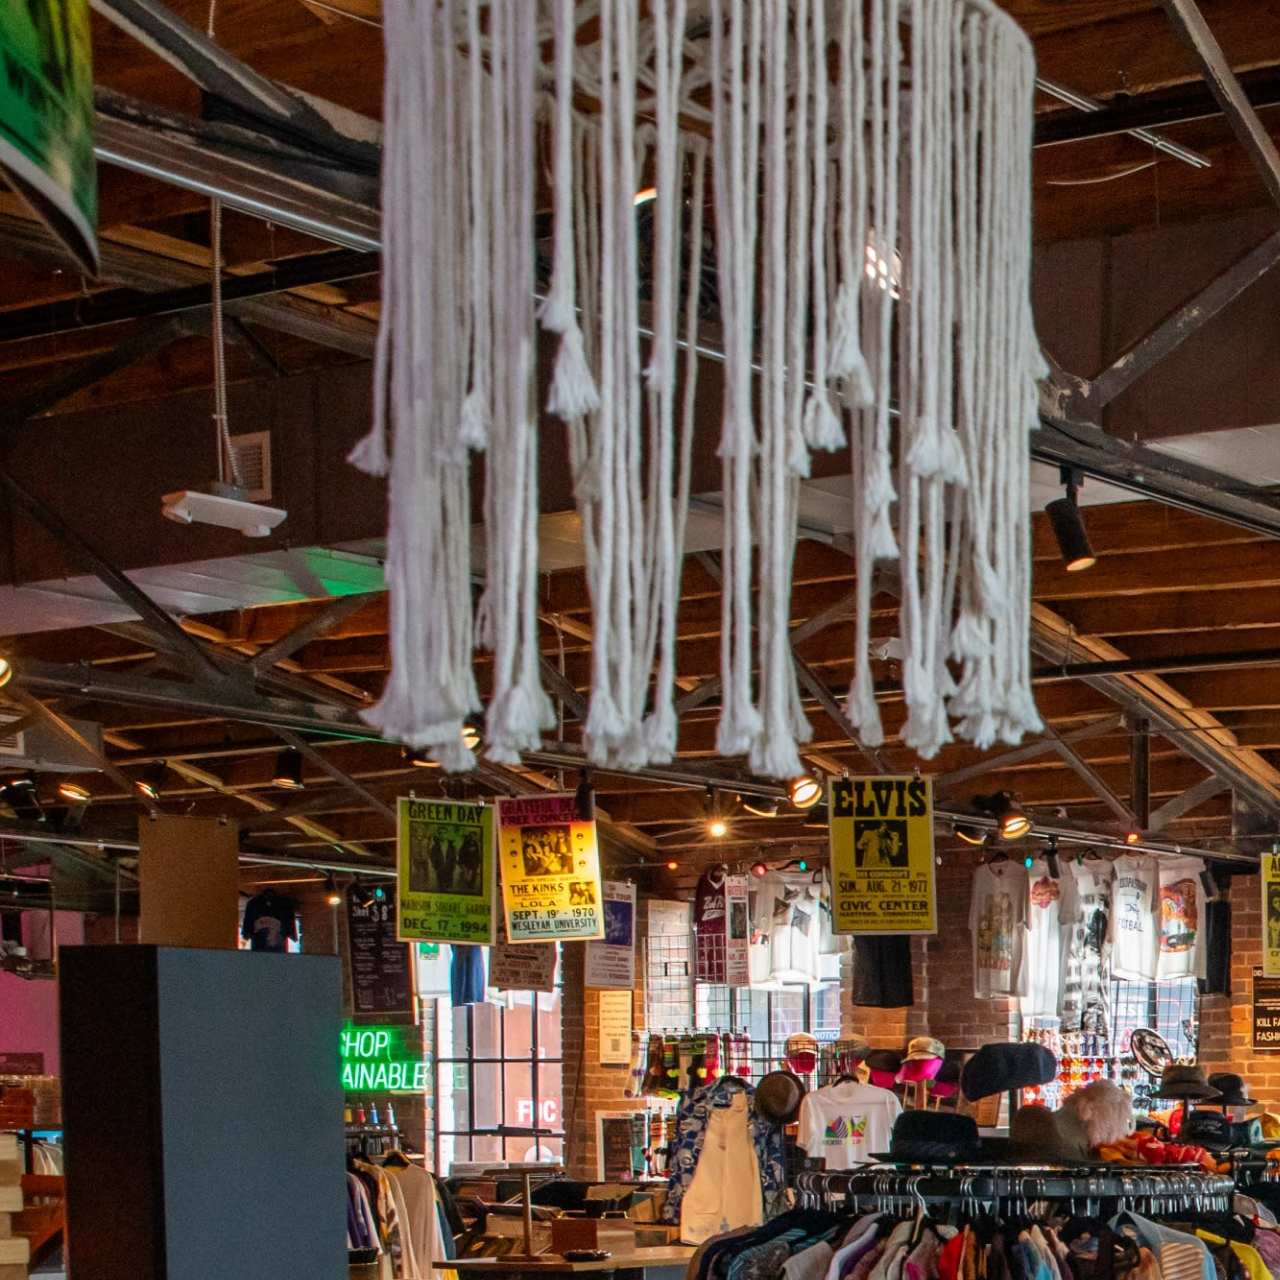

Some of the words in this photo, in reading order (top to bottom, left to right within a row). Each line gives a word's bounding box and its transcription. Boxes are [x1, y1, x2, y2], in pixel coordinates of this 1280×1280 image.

[832, 780, 927, 817] ELVIS
[409, 801, 452, 821] GREEN
[457, 805, 482, 824] DAY
[509, 884, 529, 894] THE
[532, 882, 564, 893] KINKS
[839, 900, 872, 911] CIVIC
[879, 900, 928, 911] CENTER
[512, 910, 543, 921] SEPT.
[572, 907, 594, 918] 1970
[403, 918, 432, 930] DEC.
[554, 918, 597, 929] UNIVERSITY
[1256, 1017, 1272, 1027] KILL
[815, 1031, 841, 1040] NOTIC
